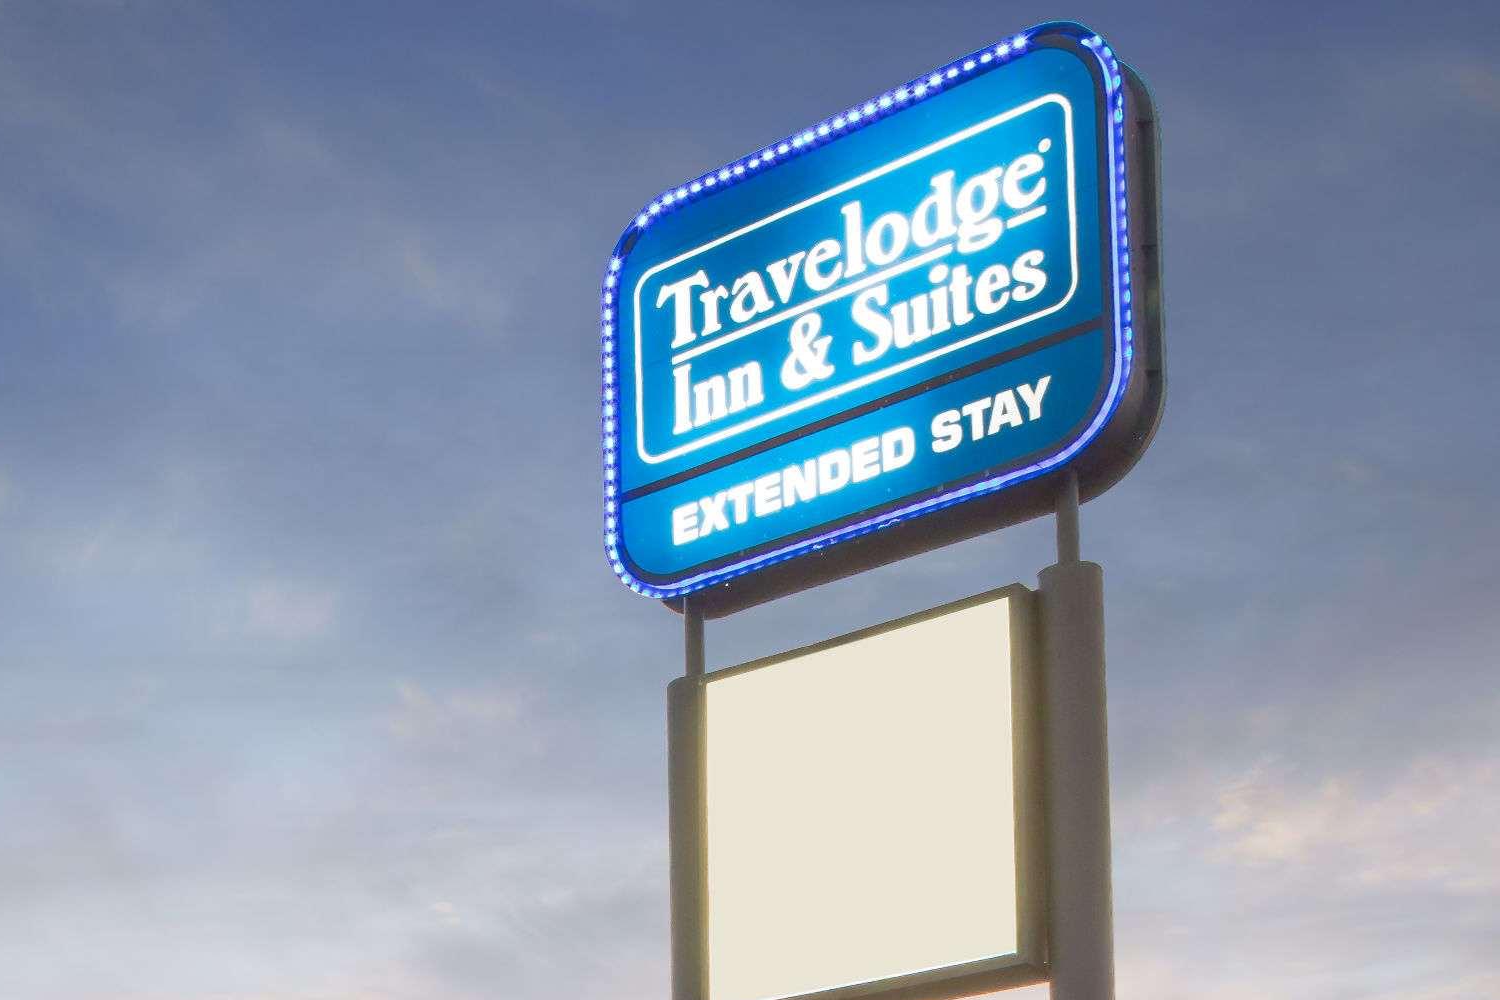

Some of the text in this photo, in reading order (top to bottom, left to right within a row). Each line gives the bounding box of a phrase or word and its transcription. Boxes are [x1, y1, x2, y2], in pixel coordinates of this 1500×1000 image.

[656, 153, 1047, 348] Travelodge
[672, 250, 1048, 435] Inn & Suites
[672, 375, 1052, 546] EXTENDED STAY
